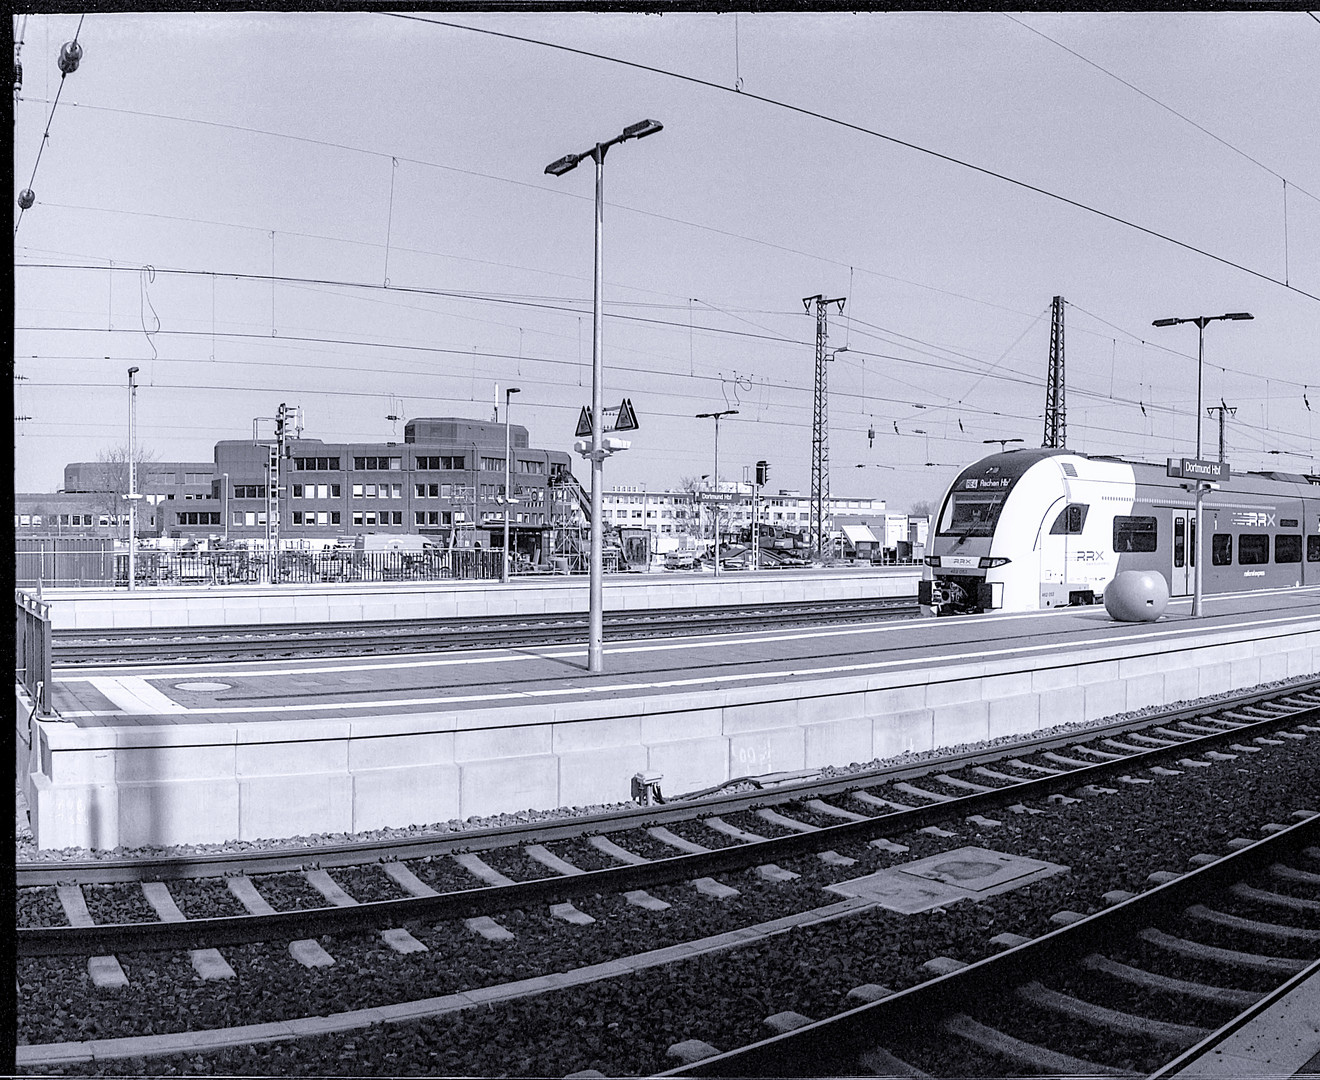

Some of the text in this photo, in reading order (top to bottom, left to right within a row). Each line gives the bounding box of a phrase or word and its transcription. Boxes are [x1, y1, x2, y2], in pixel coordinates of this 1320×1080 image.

[1185, 461, 1222, 476] Dortmund Hbf
[701, 493, 724, 501] Dortmund
[1077, 551, 1104, 561] RRX
